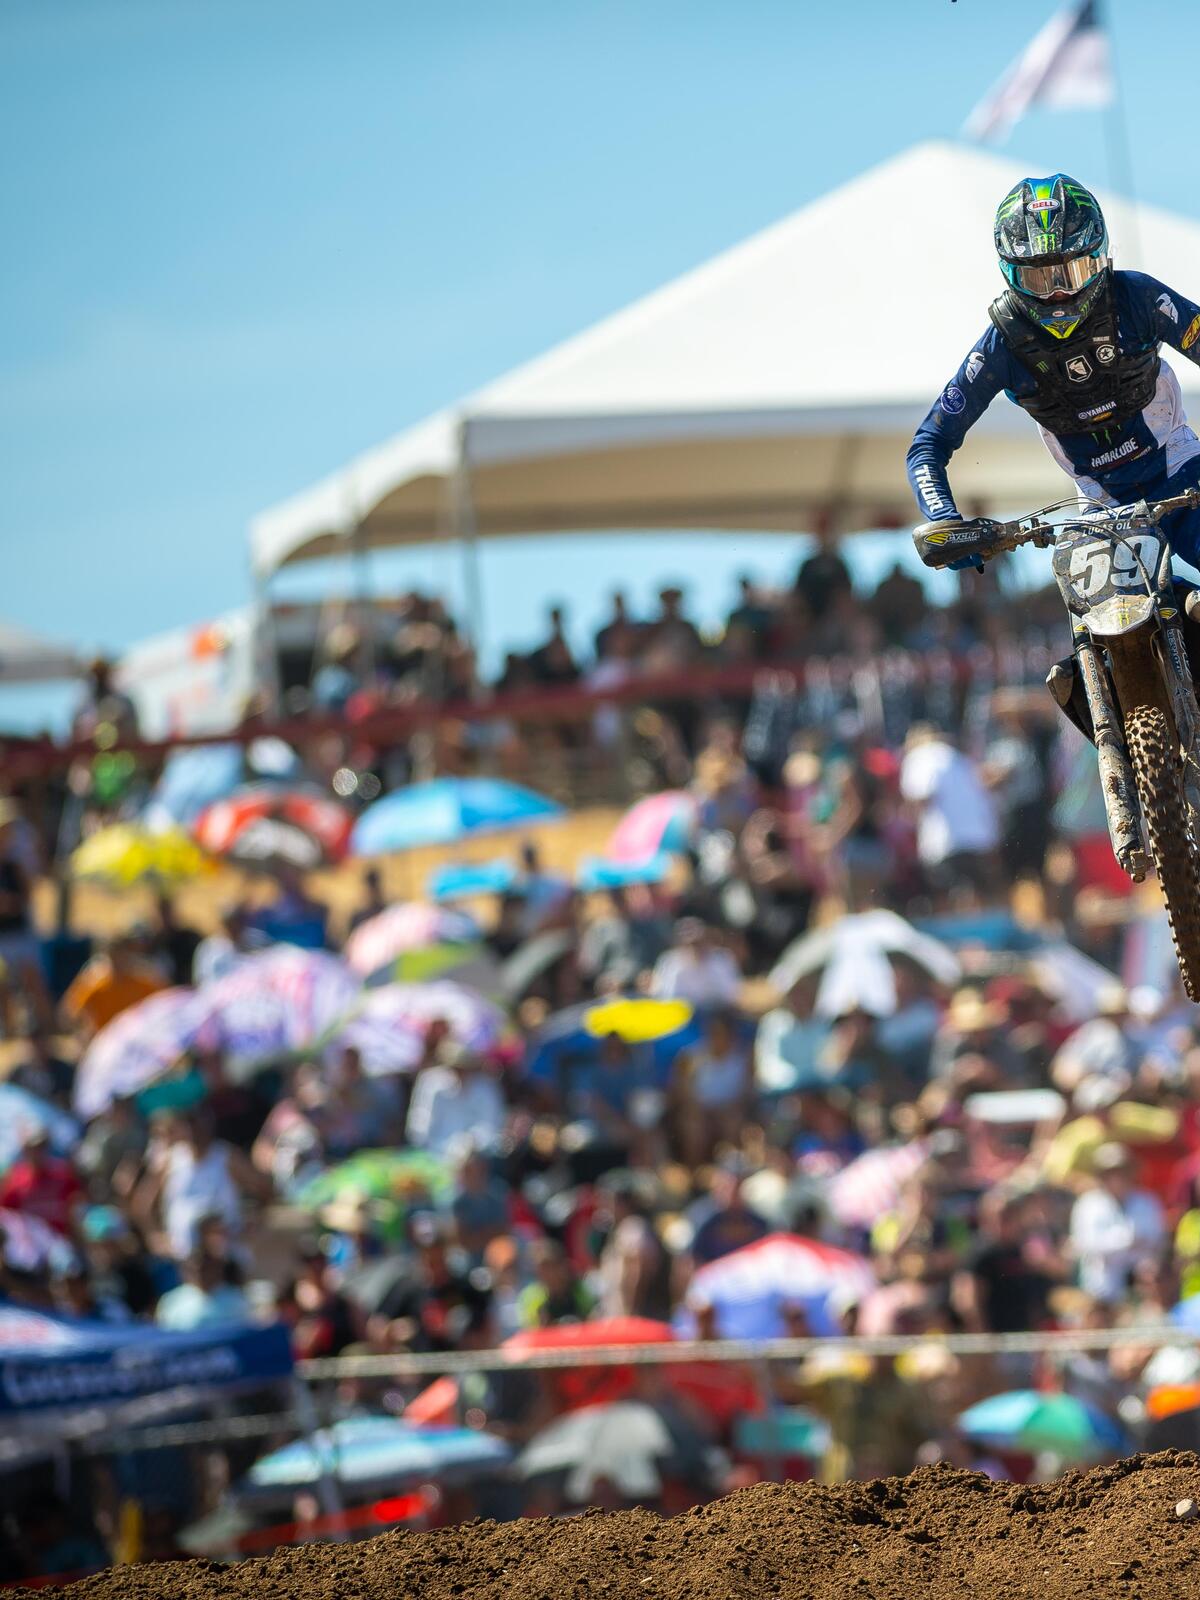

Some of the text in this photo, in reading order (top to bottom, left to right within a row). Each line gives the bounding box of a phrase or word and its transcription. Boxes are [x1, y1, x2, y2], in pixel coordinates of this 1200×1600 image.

[1033, 201, 1054, 209] BELL
[1087, 401, 1117, 417] YAMAHA
[914, 464, 944, 513] THOR
[1116, 522, 1132, 531] OIL
[1069, 535, 1160, 599] 59
